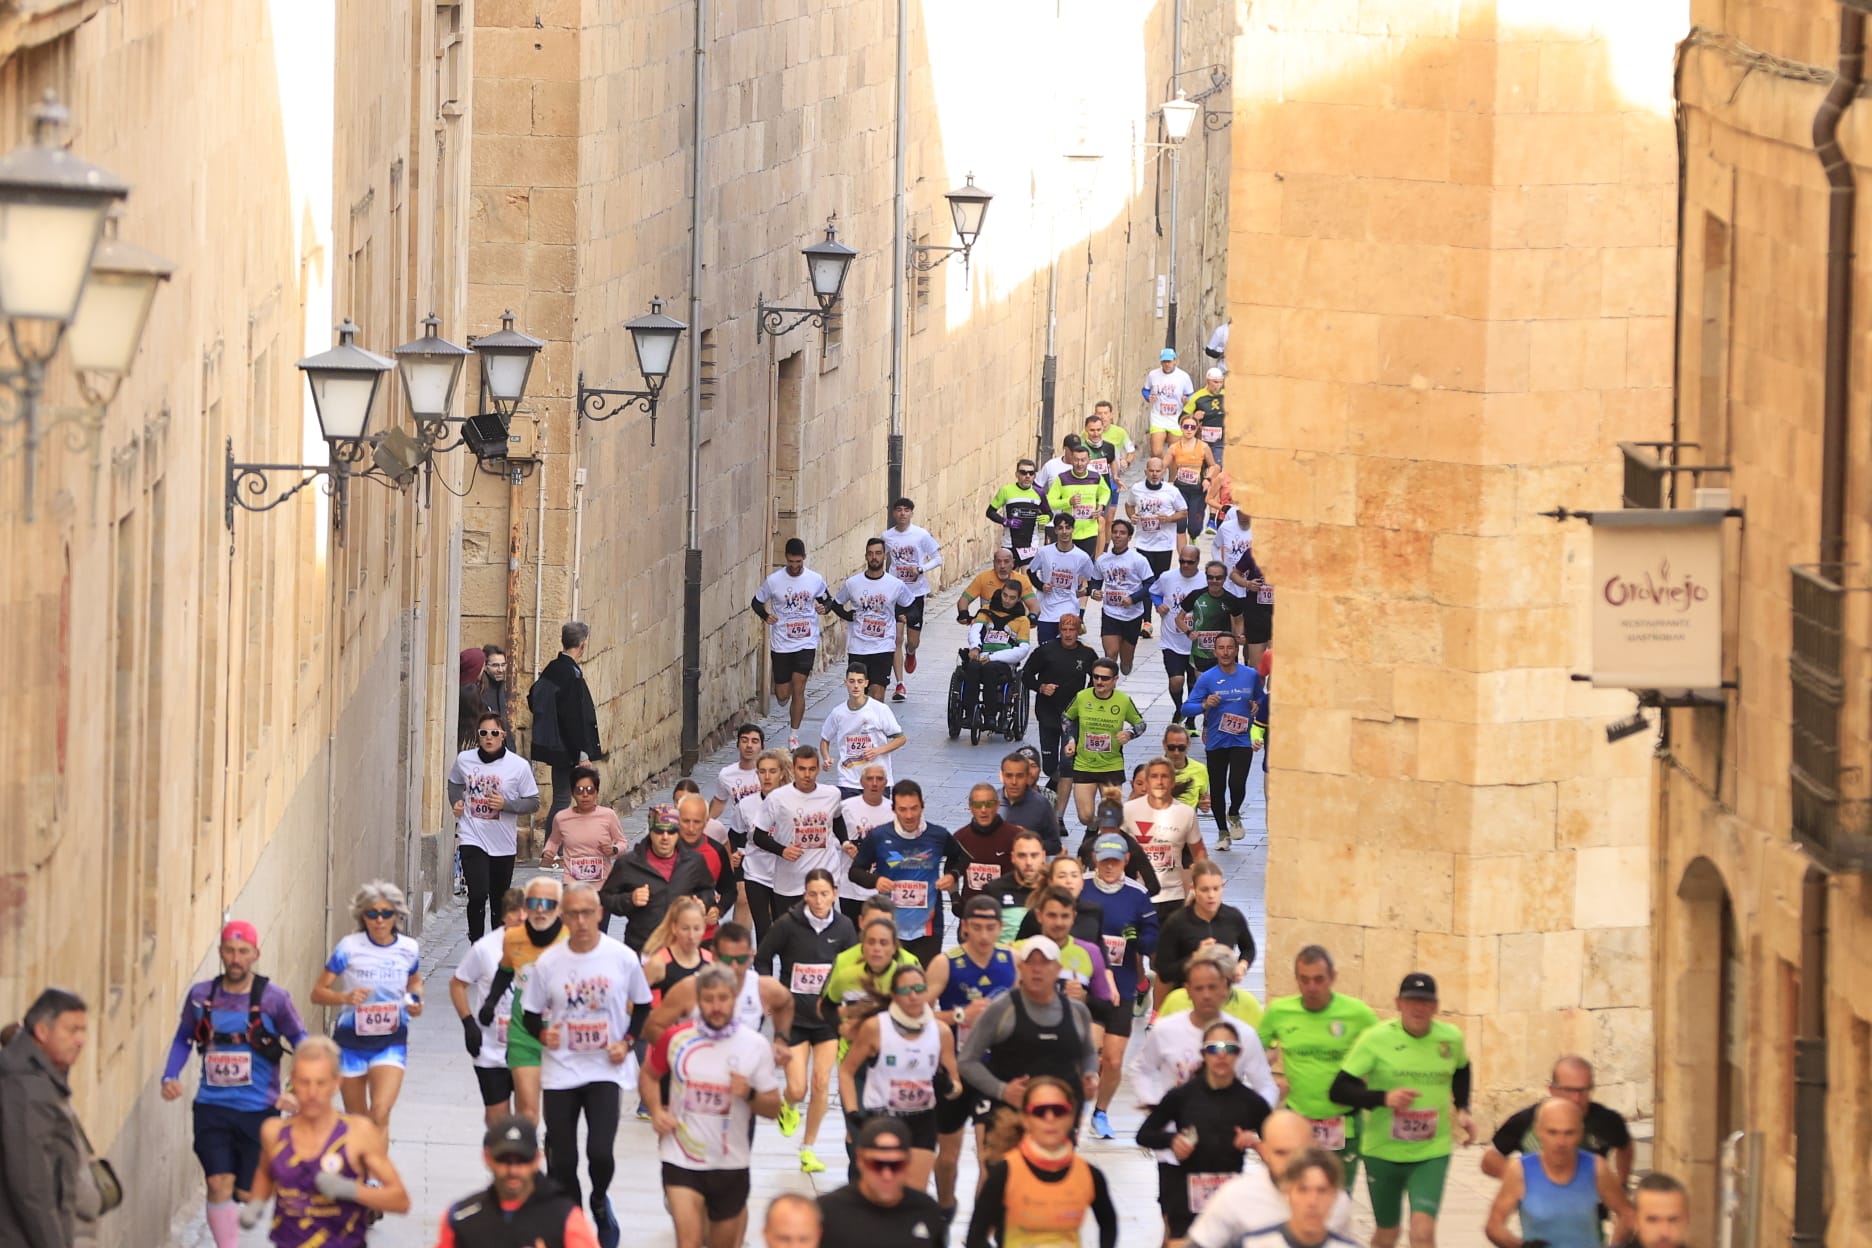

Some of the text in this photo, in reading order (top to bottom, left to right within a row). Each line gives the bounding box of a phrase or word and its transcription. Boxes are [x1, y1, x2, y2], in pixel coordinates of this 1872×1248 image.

[851, 741, 866, 750] 624
[1090, 739, 1105, 748] 587
[801, 833, 820, 843] 696
[579, 864, 596, 874] 143
[973, 872, 993, 882] 248
[902, 889, 916, 899] 24
[801, 974, 823, 985] 629
[366, 1012, 390, 1025] 604
[575, 1031, 600, 1043] 318
[215, 1063, 239, 1076] 463
